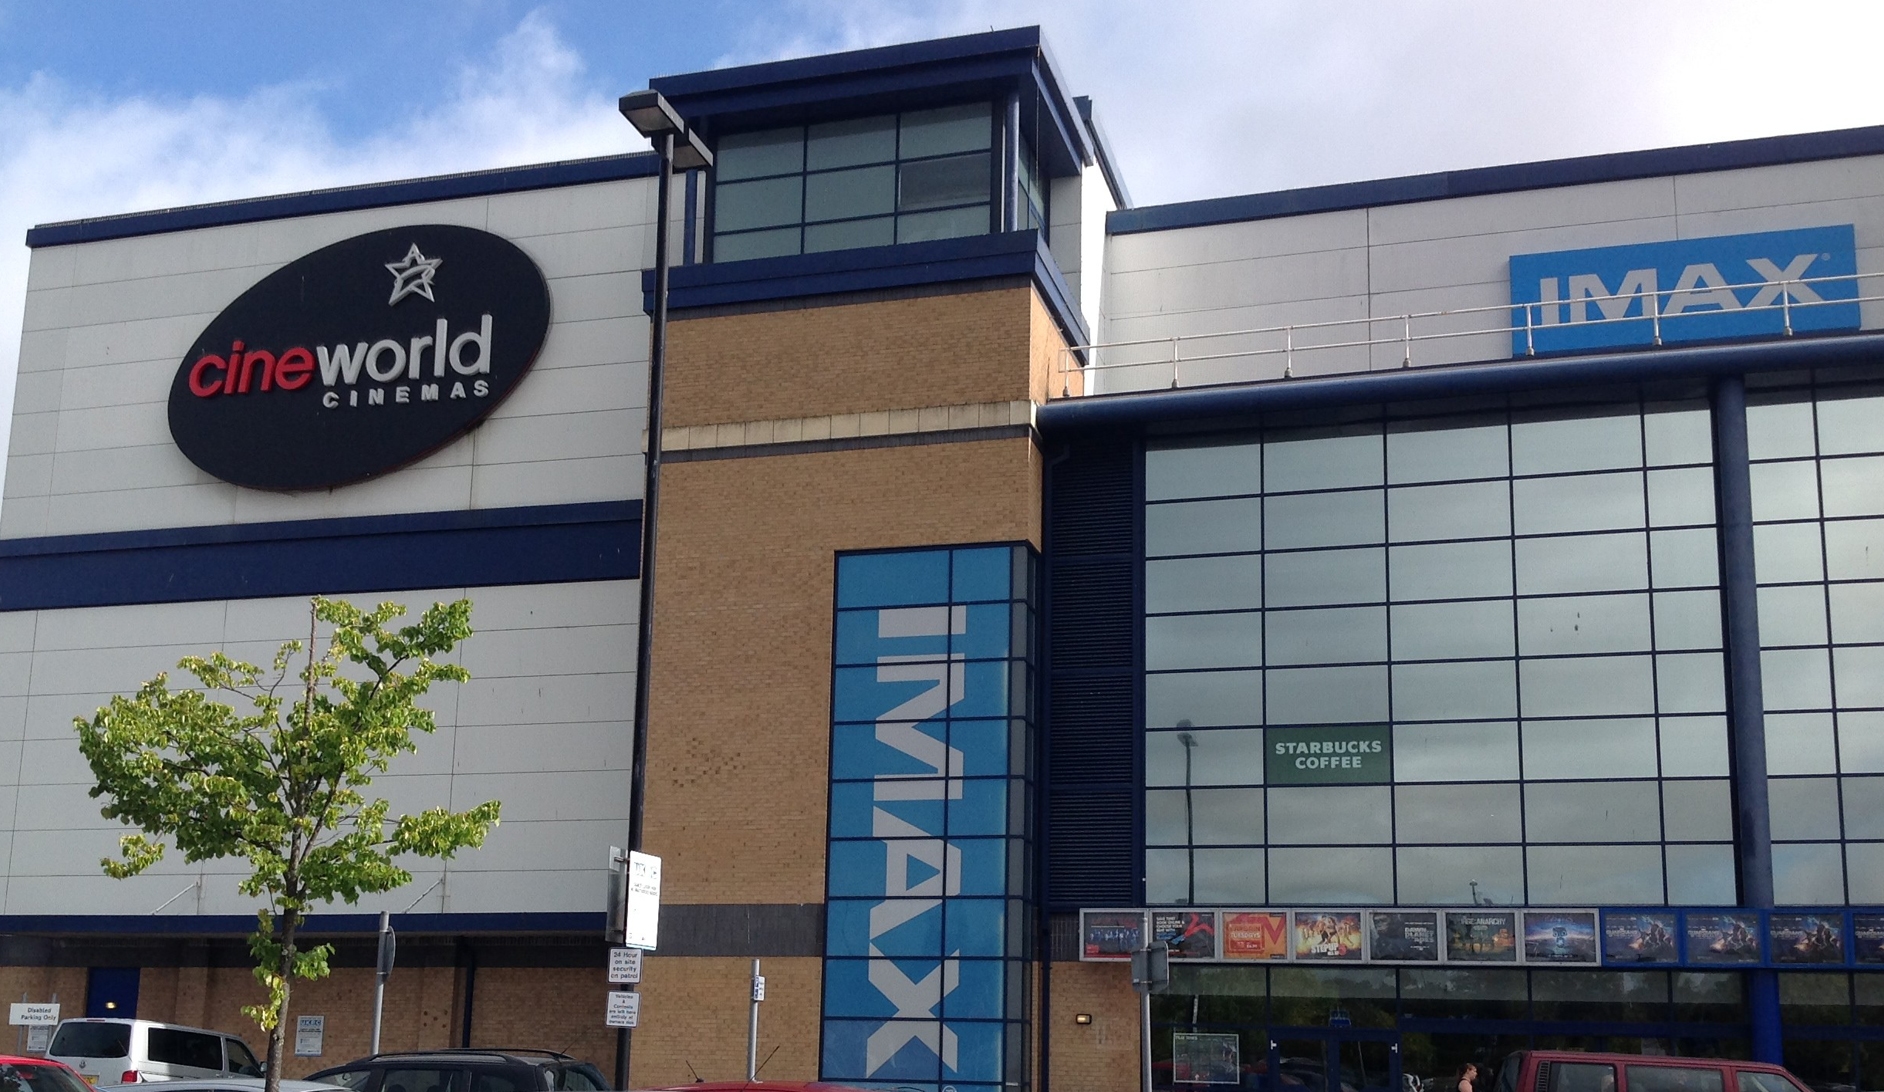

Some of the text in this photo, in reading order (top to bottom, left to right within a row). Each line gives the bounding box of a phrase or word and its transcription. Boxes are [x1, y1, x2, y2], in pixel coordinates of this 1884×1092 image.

[1540, 254, 1824, 328] IMAX
[189, 313, 493, 398] cineworld
[323, 380, 490, 408] CINEMAS
[1275, 740, 1382, 755] STARBUCKS
[1295, 757, 1362, 769] COFFEE
[866, 605, 967, 1079] IMAX
